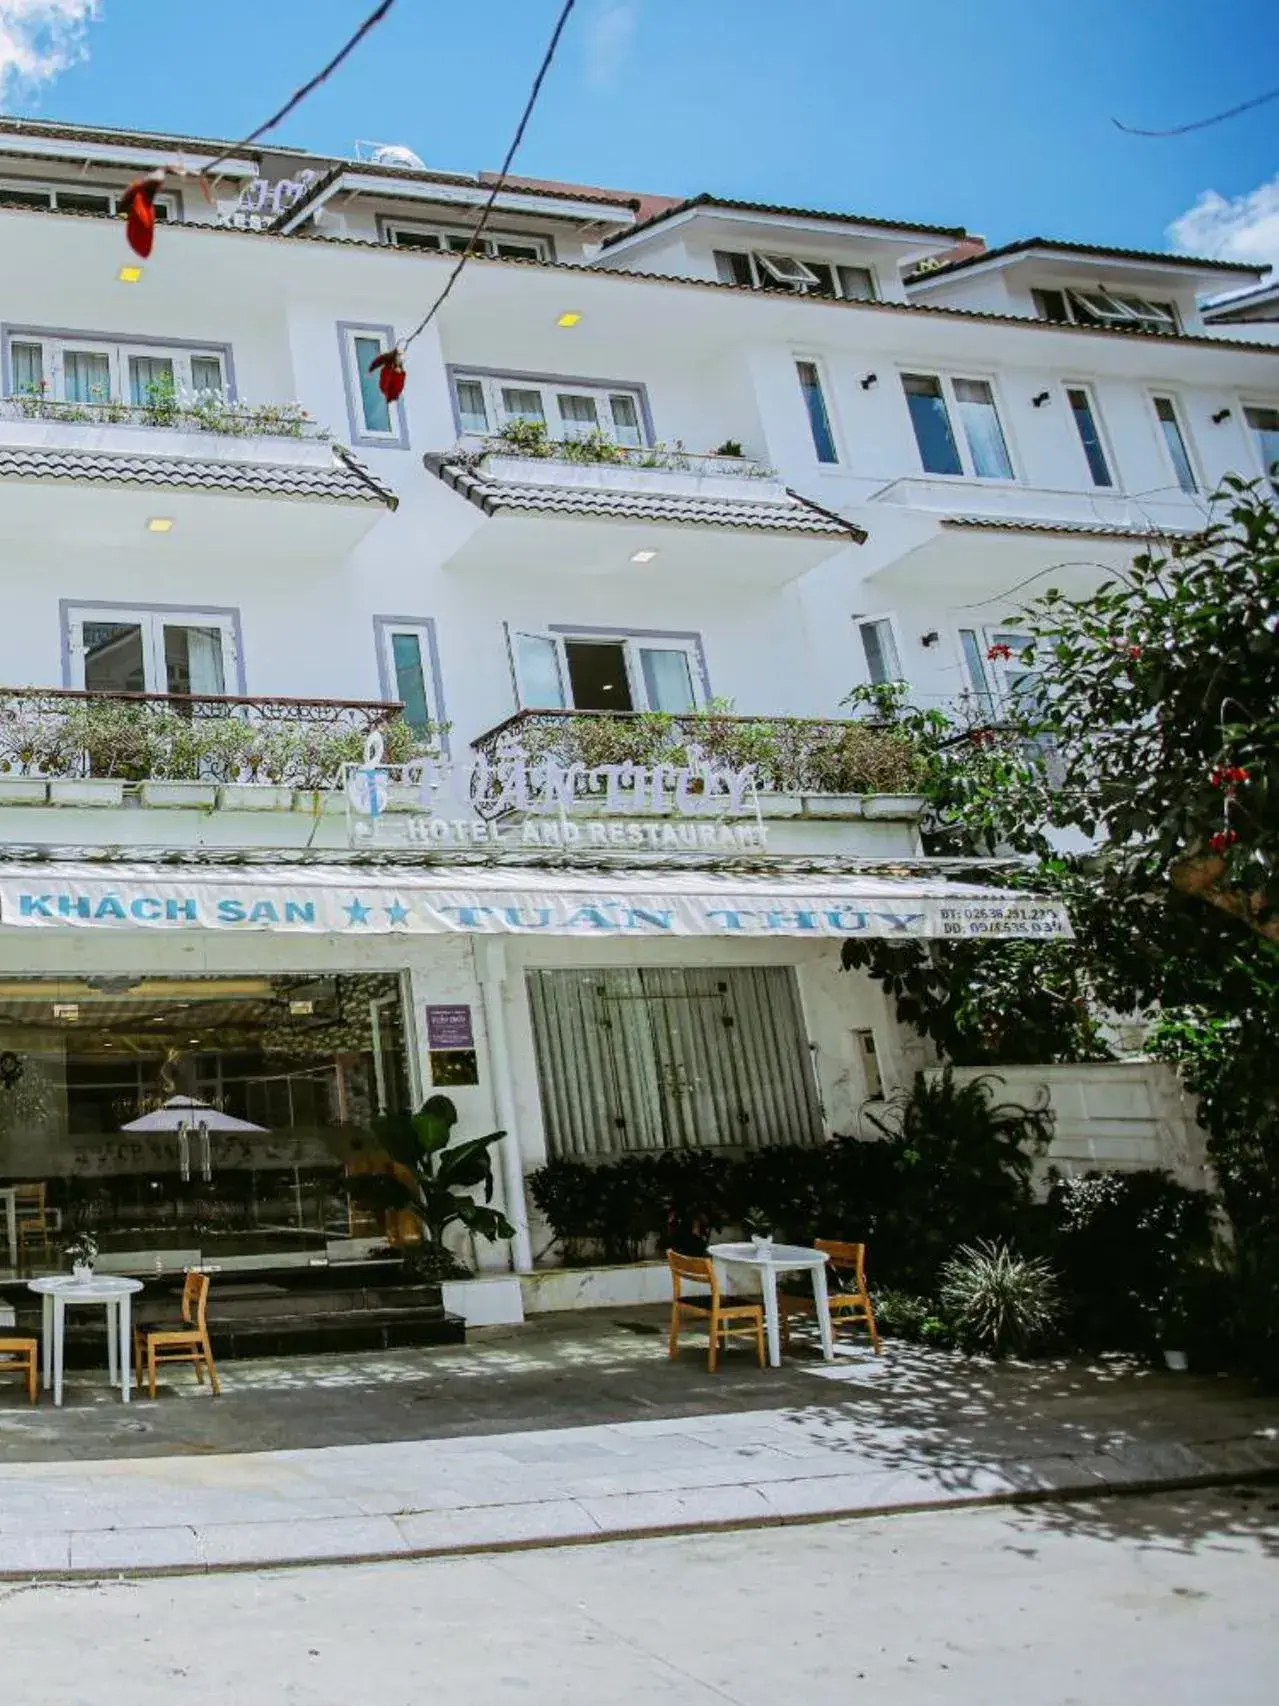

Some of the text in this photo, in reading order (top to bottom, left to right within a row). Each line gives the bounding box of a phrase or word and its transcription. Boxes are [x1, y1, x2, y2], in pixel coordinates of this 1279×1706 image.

[408, 818, 769, 848] HOTEL AND RESTAURANT
[19, 891, 197, 921] KHÁCH
